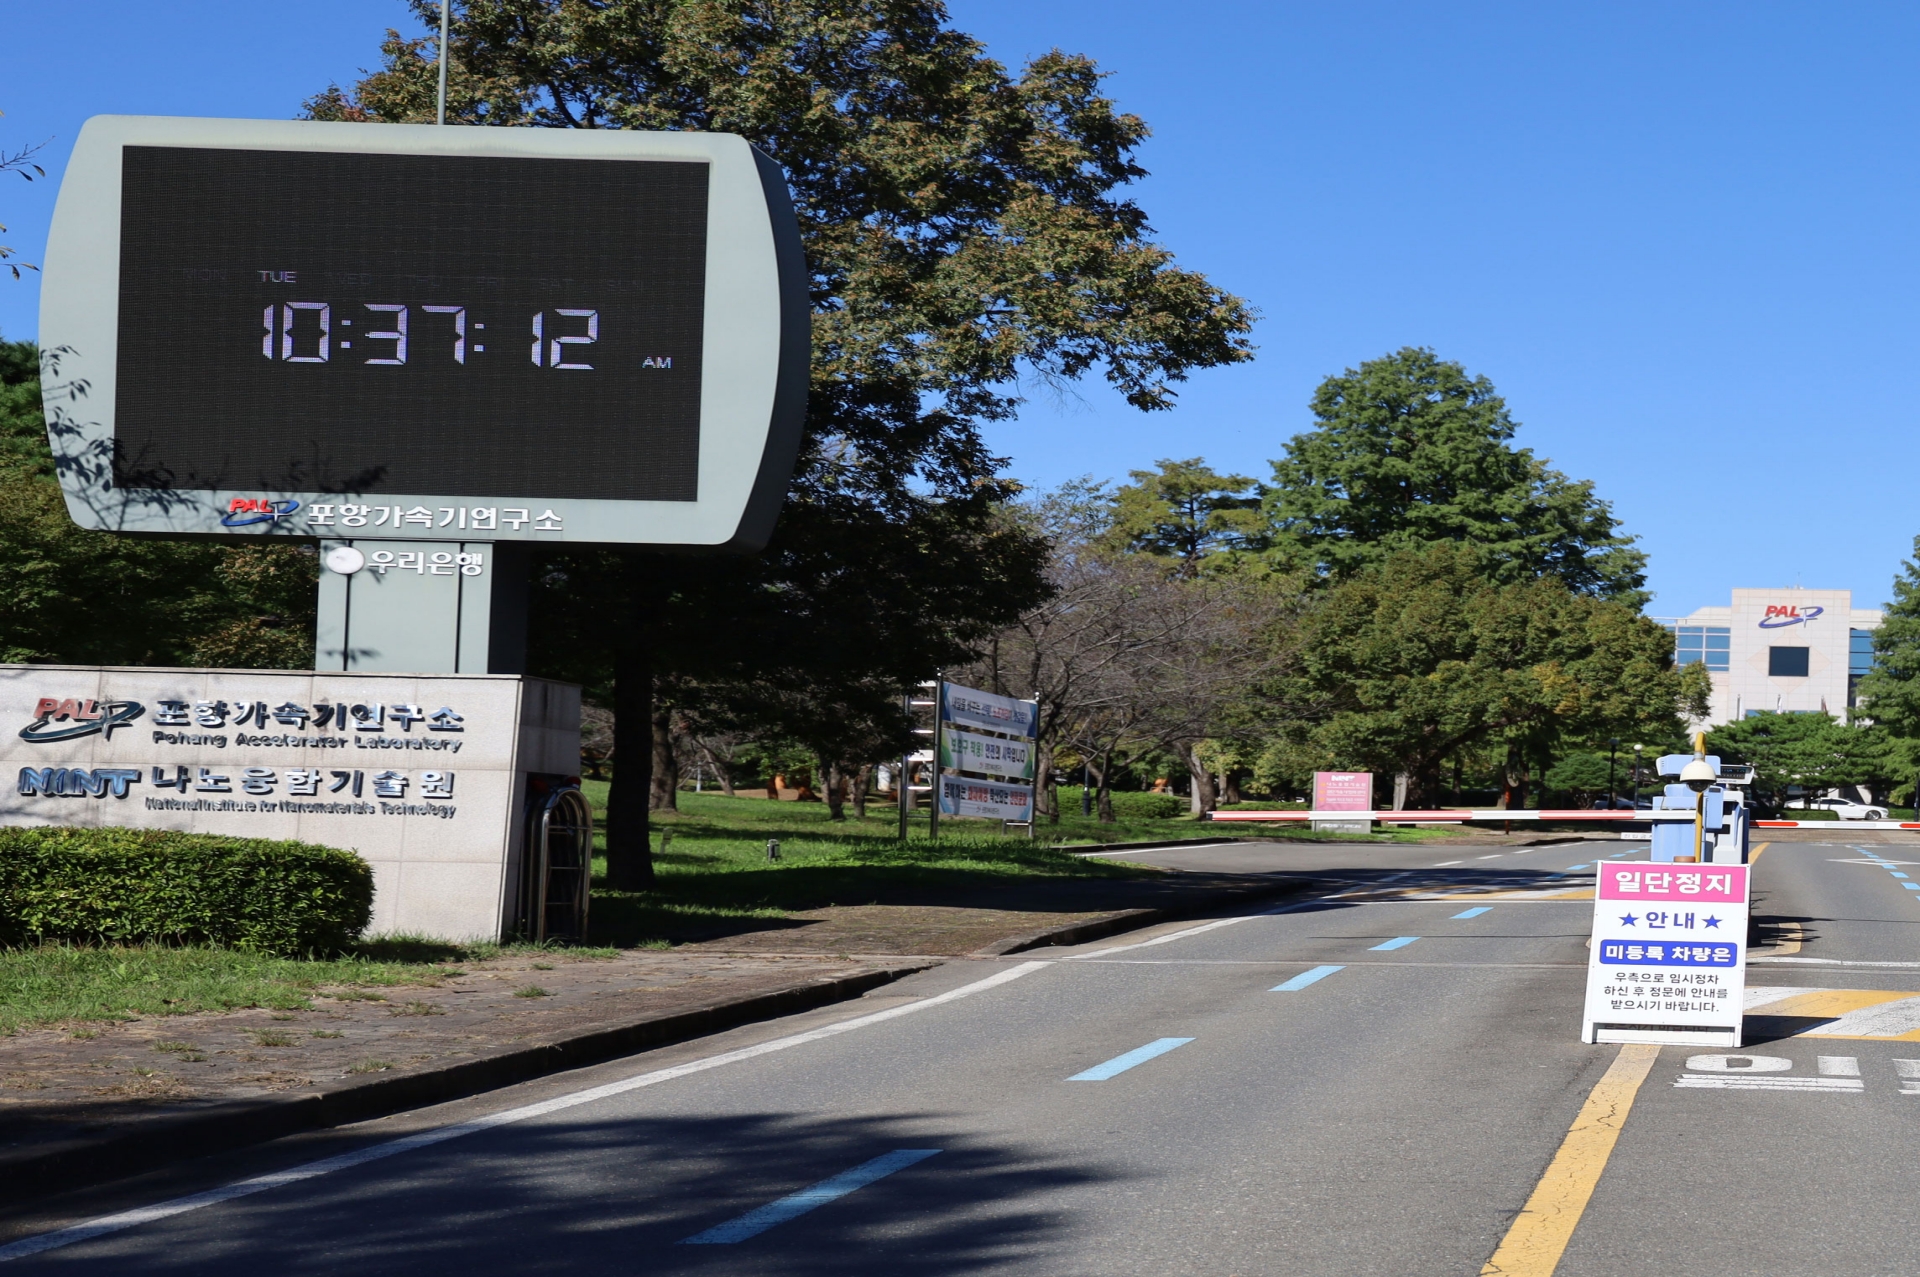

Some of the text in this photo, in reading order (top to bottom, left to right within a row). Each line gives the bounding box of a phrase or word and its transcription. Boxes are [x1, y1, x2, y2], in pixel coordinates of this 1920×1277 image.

[257, 270, 297, 283] TUE
[642, 356, 672, 369] AM
[228, 498, 274, 514] PAL
[307, 503, 564, 532] 포항가속기연구소
[367, 550, 484, 577] 우리은행
[1764, 605, 1801, 618] PAL
[33, 698, 101, 720] PAL
[153, 699, 464, 732] 포항가속기연구소
[152, 731, 462, 753] Pohang Accelerator Laboratory
[17, 766, 141, 799] NINT
[152, 765, 455, 799] 나노융합기술원
[145, 797, 201, 812] National
[259, 799, 277, 812] for
[279, 800, 376, 815] Nanomaterials
[379, 802, 456, 819] Technology
[1615, 871, 1732, 895] 일단정지
[1645, 911, 1695, 929] 안내
[1605, 944, 1731, 962] 미등록 차량은
[1614, 972, 1720, 985] 우측으로 임시정차
[1604, 985, 1729, 999] 하신 후 정문에 안내를
[1610, 999, 1720, 1012] 받으시기 바랍니다.
